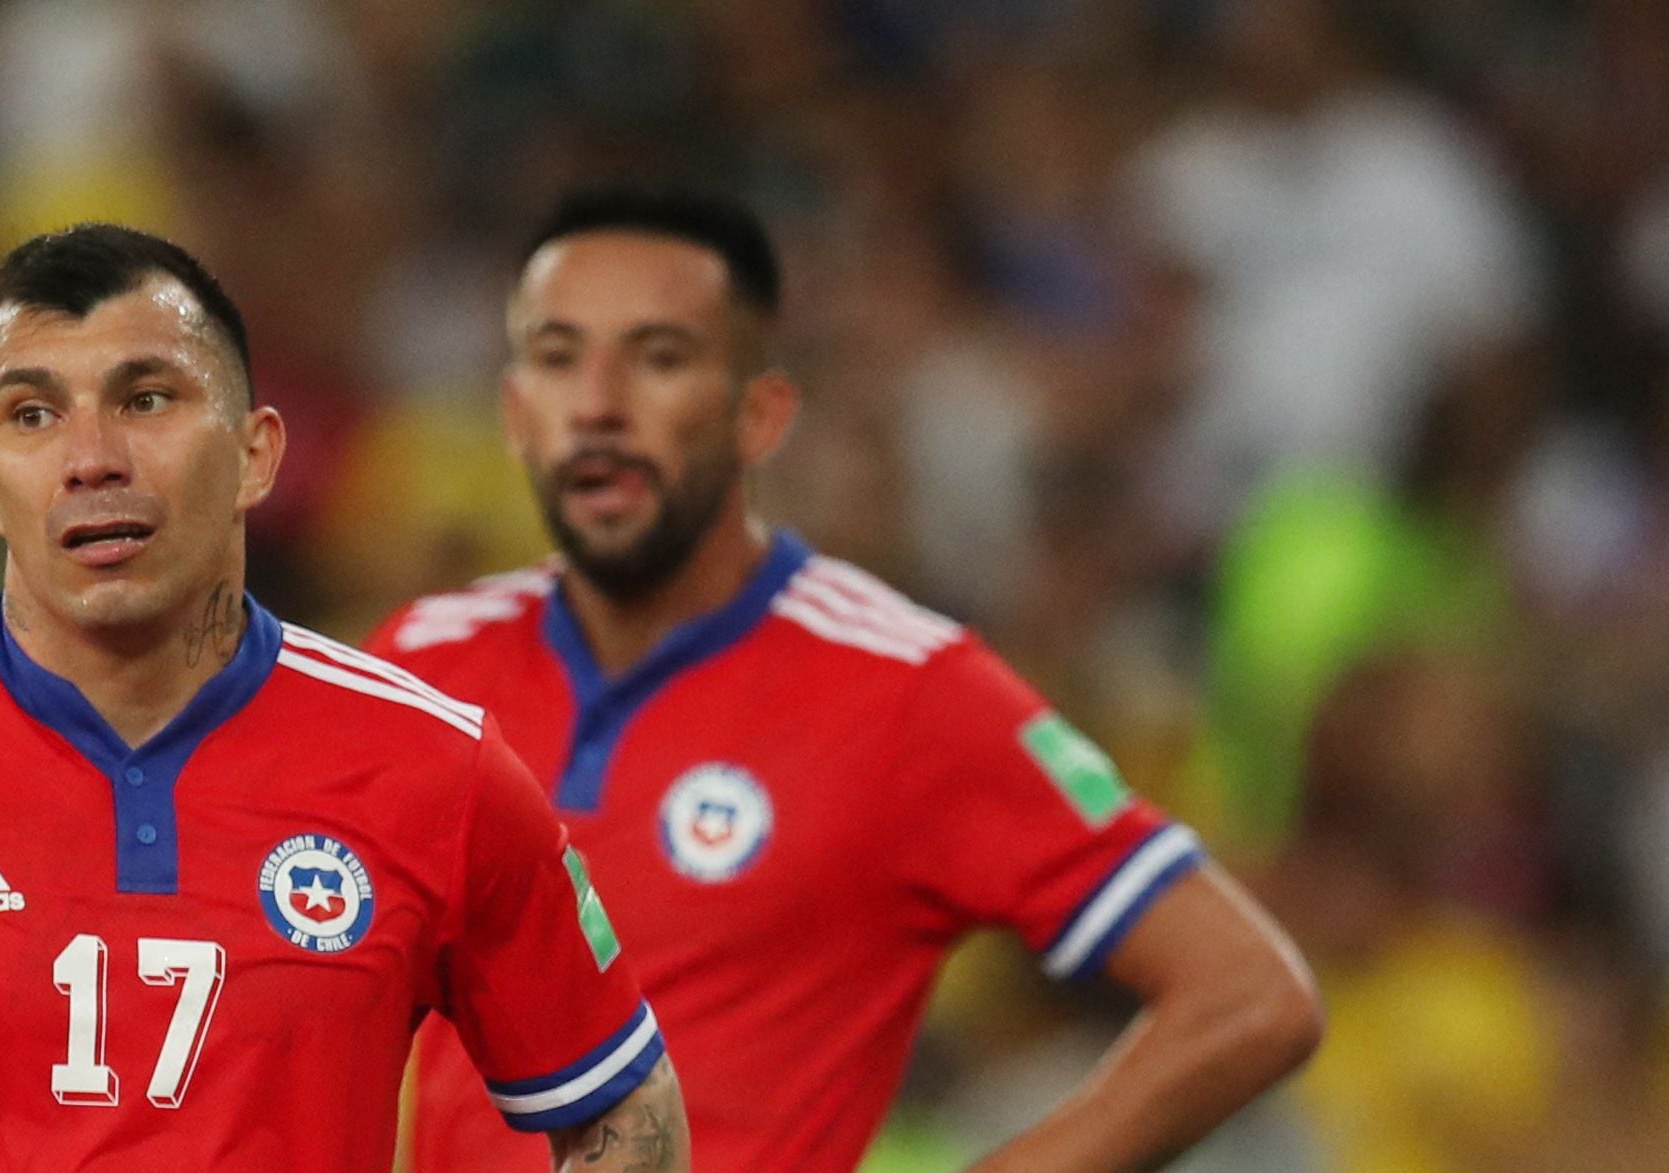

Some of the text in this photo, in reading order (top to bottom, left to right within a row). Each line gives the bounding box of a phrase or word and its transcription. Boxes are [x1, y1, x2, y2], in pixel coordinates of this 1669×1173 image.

[259, 835, 372, 900] FEDERACION DE FUTBOL
[291, 930, 351, 952] DE CHILE
[51, 933, 226, 1109] 17
